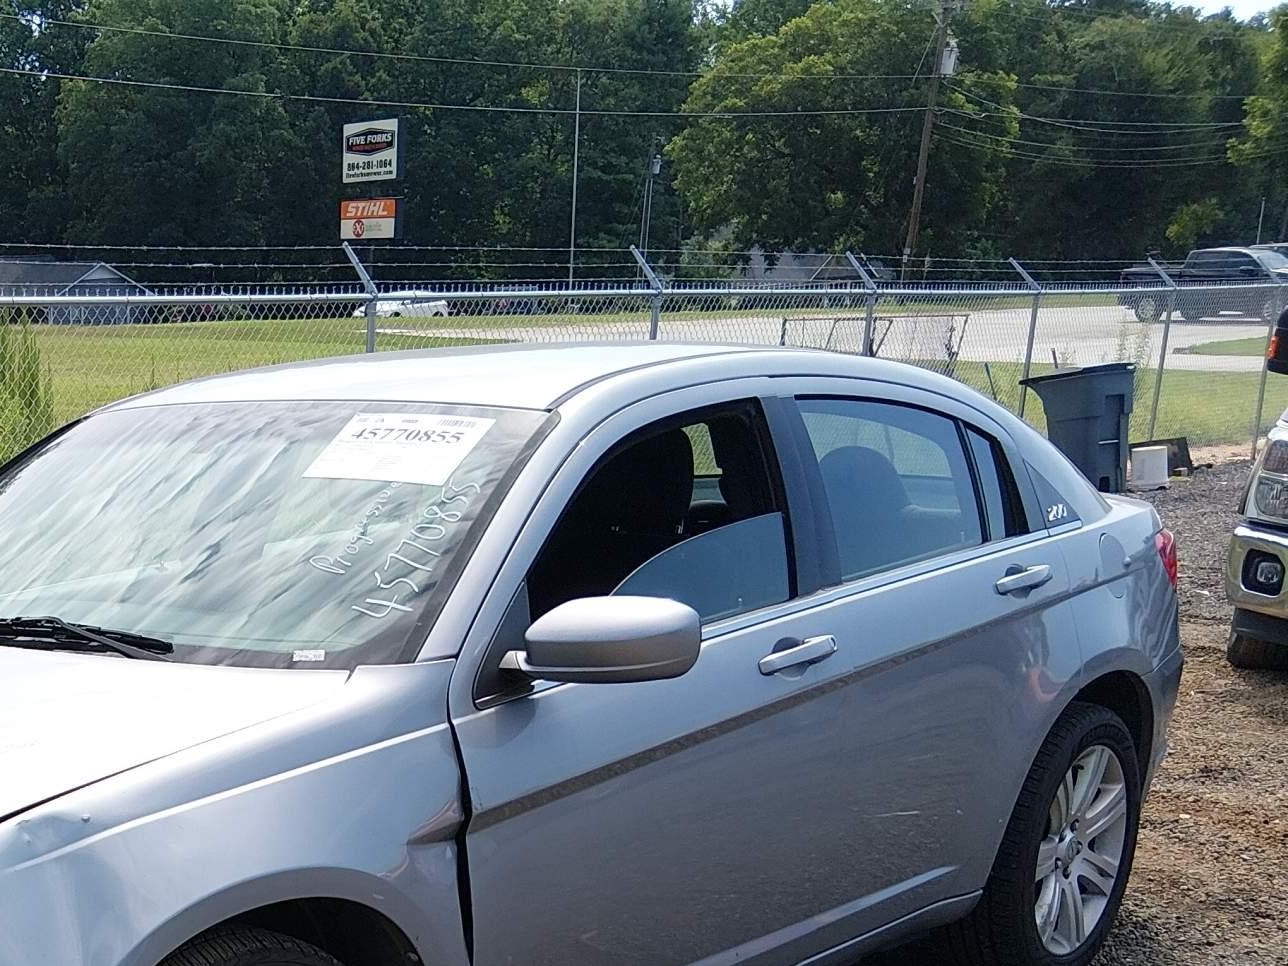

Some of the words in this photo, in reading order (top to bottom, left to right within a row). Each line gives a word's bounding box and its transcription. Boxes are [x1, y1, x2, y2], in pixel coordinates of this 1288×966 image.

[348, 135, 366, 146] FIVE
[366, 132, 392, 144] FORKS
[346, 201, 388, 217] STIHL
[352, 427, 465, 445] 45770855
[351, 476, 481, 618] 45770855
